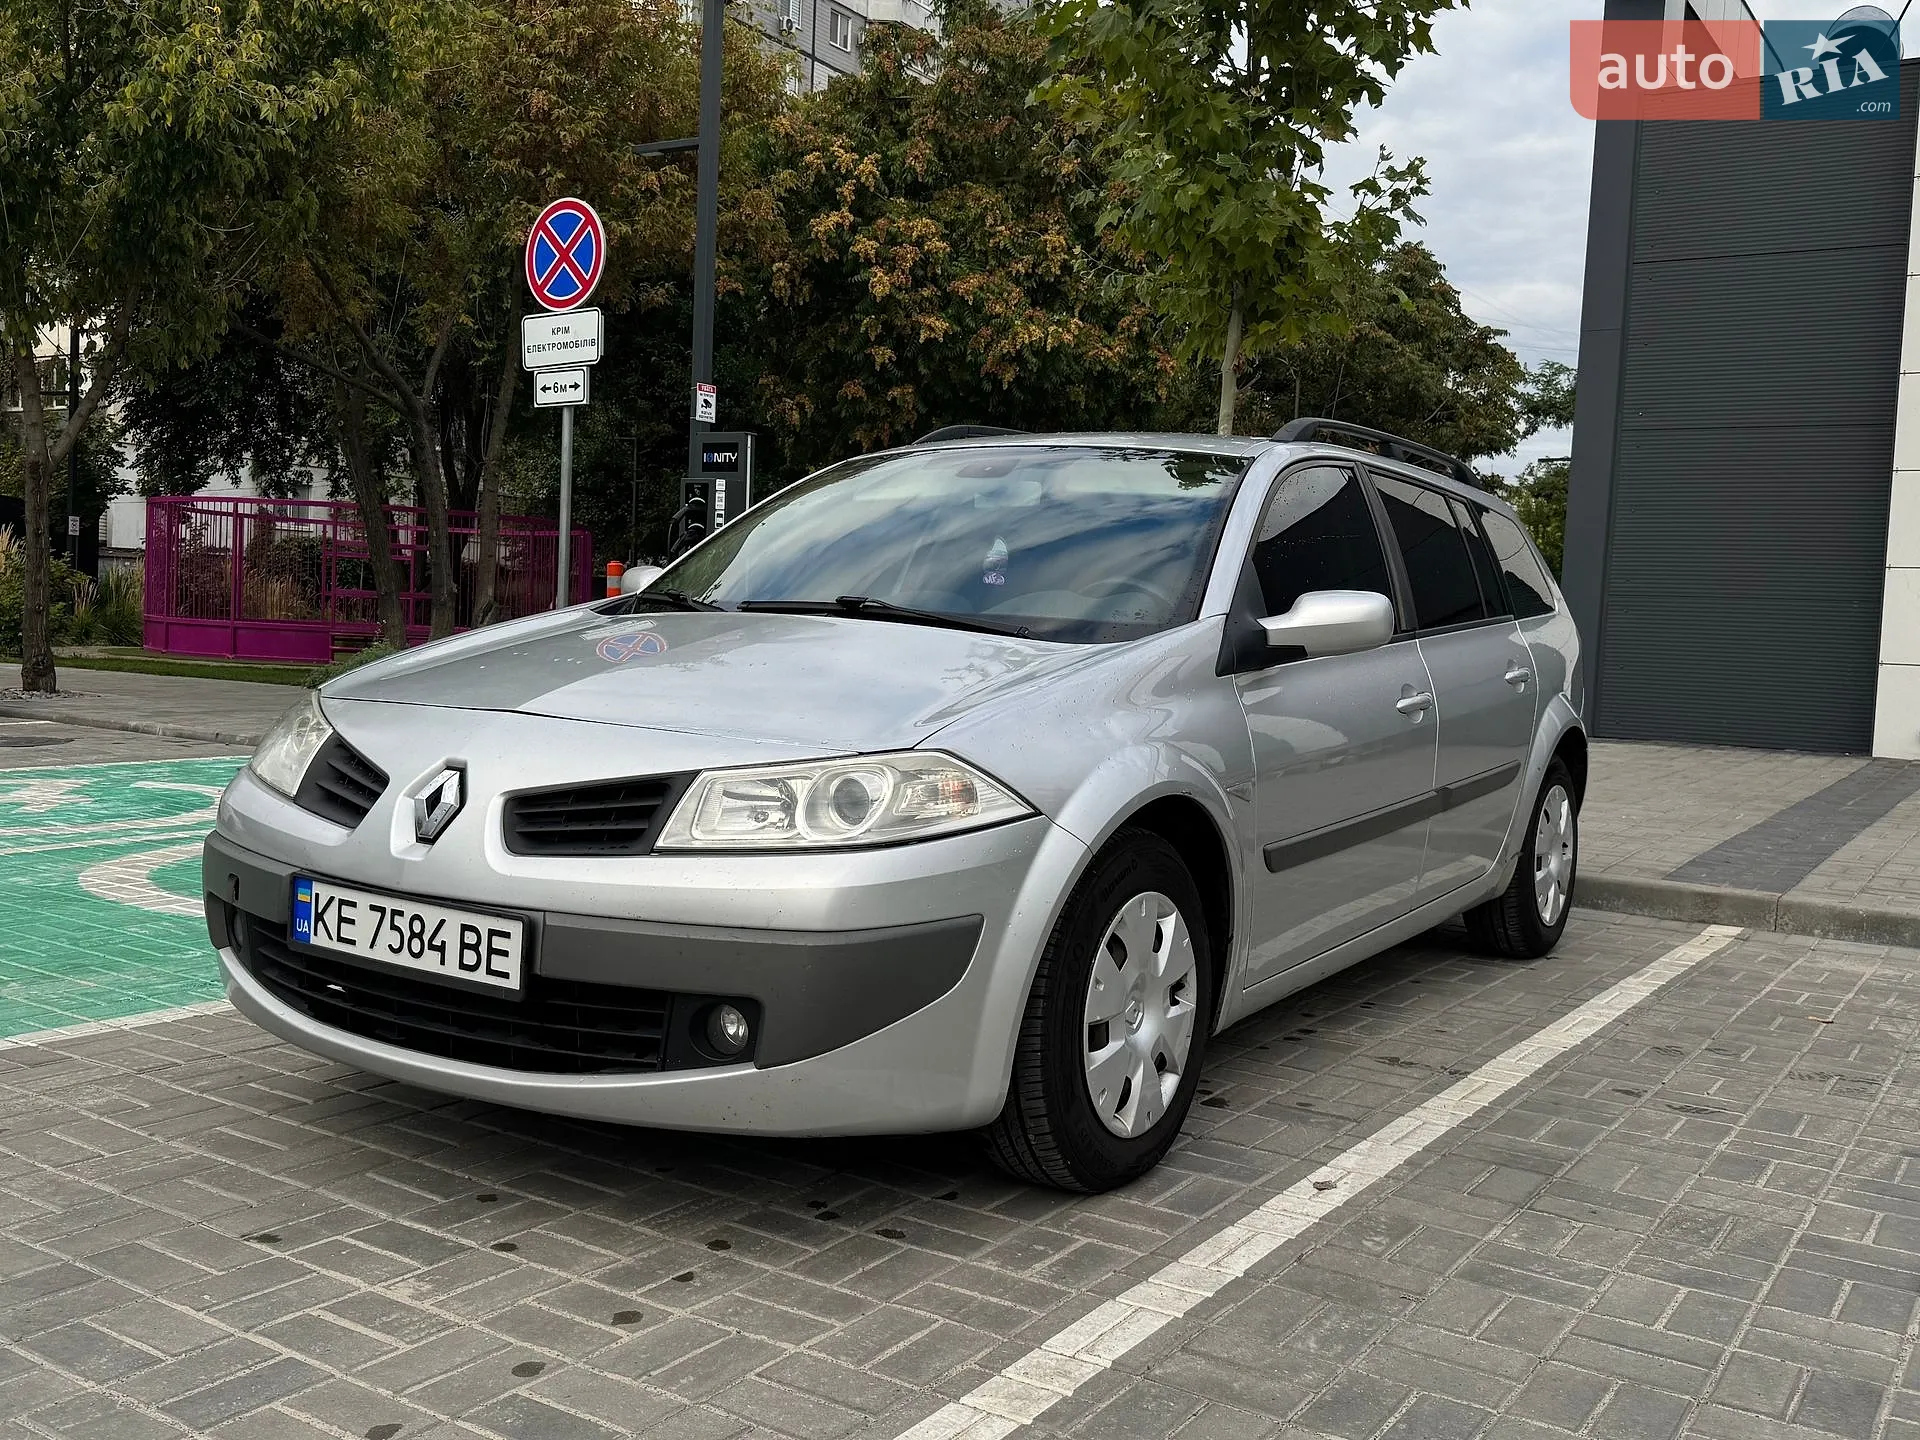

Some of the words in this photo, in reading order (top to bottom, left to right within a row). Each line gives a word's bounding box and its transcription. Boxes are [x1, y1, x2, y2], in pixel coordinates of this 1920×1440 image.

[551, 325, 571, 336] КРІМ
[526, 338, 597, 354] ЕЛЕКТРОМОБІЛІВ
[703, 452, 738, 463] IONITY
[296, 918, 310, 934] UA
[313, 892, 358, 946] KE
[368, 903, 447, 966] 7584
[458, 922, 512, 980] BE
